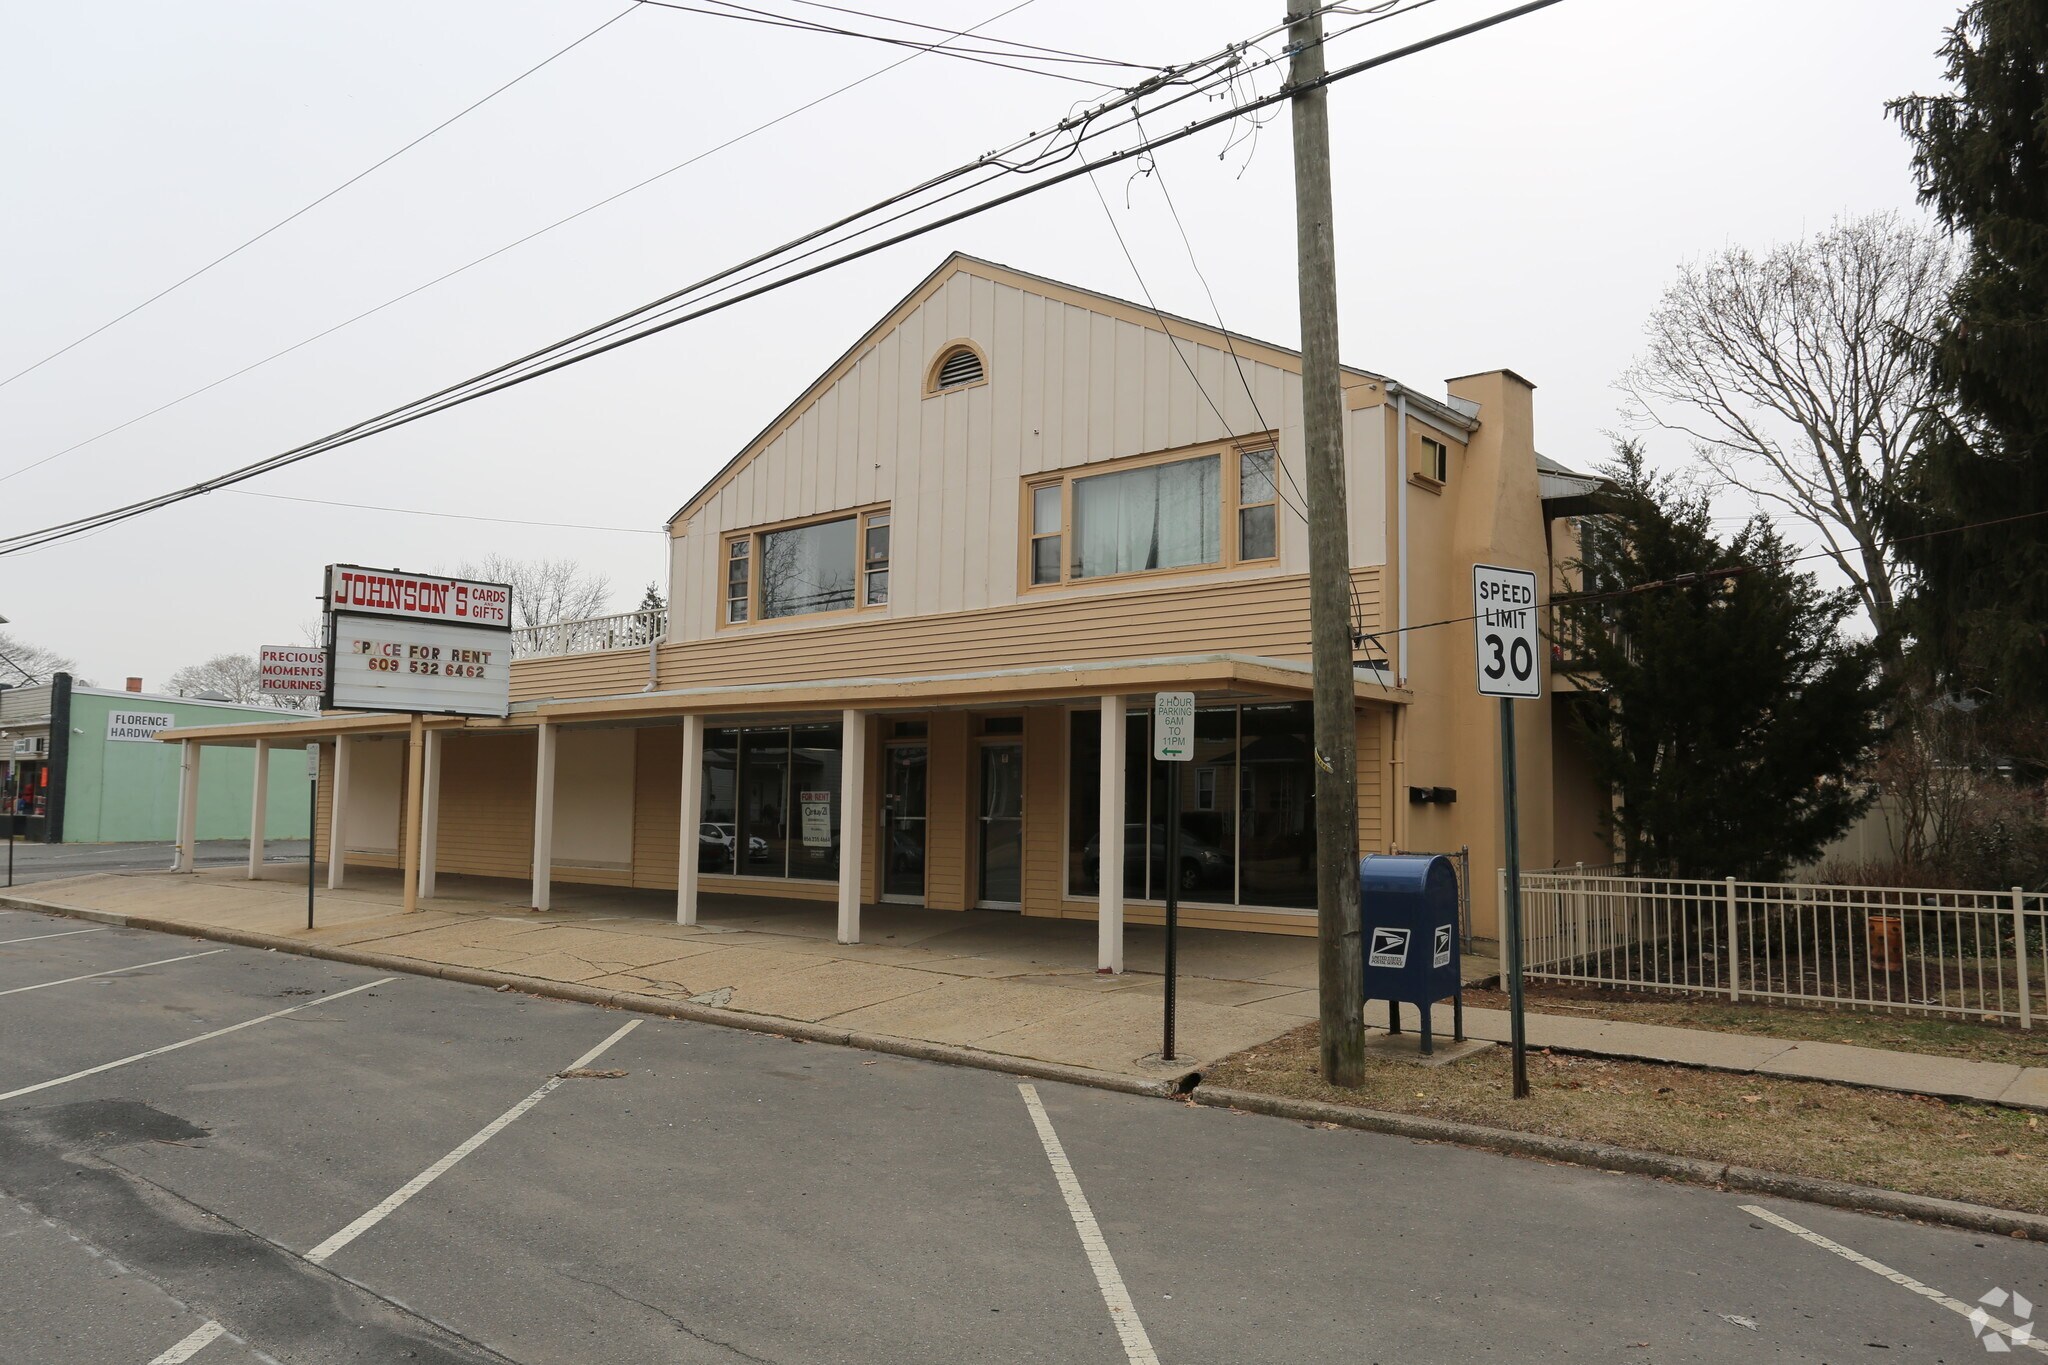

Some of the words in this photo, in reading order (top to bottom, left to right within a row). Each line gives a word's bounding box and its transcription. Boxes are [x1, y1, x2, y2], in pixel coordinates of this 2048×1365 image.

[335, 572, 468, 616] JOHNSON'S
[472, 588, 506, 603] CARDS
[1480, 581, 1532, 604] SPEED
[472, 605, 504, 620] GIFTS
[1485, 607, 1527, 629] LIMIT
[262, 651, 324, 663] PRECIOUS
[409, 645, 441, 660] FOR
[451, 649, 492, 664] RENT
[1484, 634, 1533, 681] 30
[262, 665, 323, 677] MOMENTS
[368, 658, 400, 672] 609
[409, 660, 440, 675] 532
[445, 663, 485, 678] 6462
[262, 678, 322, 690] FIGURINES
[1159, 698, 1165, 706] 2
[1166, 698, 1192, 707] HOUR
[1158, 707, 1192, 716] PARKING
[115, 714, 168, 727] FLORENCE
[1165, 716, 1184, 725] 6AM
[1169, 726, 1181, 735] TO
[1163, 737, 1185, 745] 11PM
[814, 793, 829, 801] RENT
